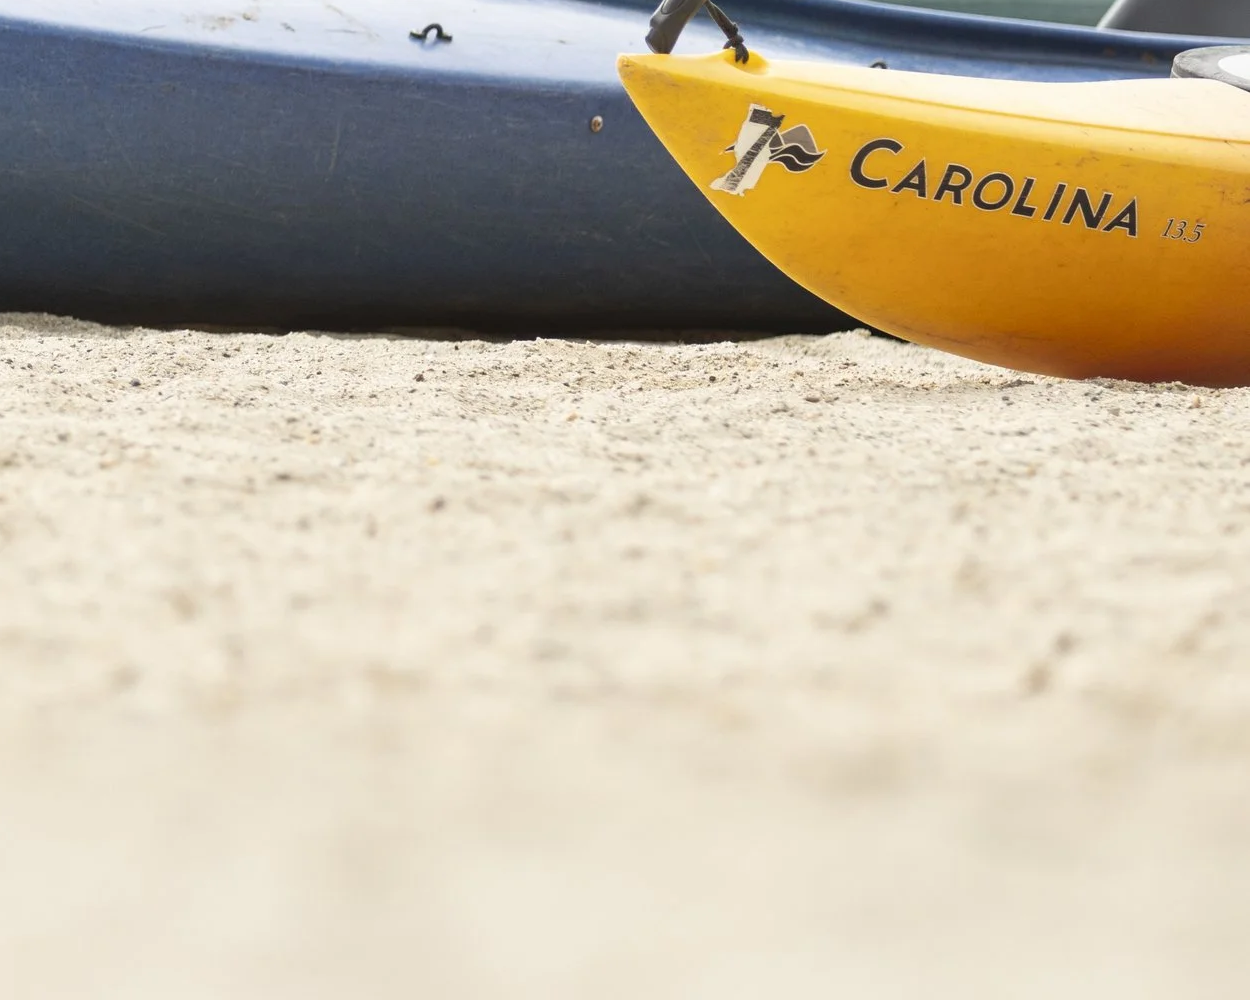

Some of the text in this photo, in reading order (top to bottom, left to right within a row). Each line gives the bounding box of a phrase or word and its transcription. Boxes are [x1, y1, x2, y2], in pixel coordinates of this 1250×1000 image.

[721, 108, 785, 191] 7
[850, 138, 1206, 243] CAROLINA 13.5
